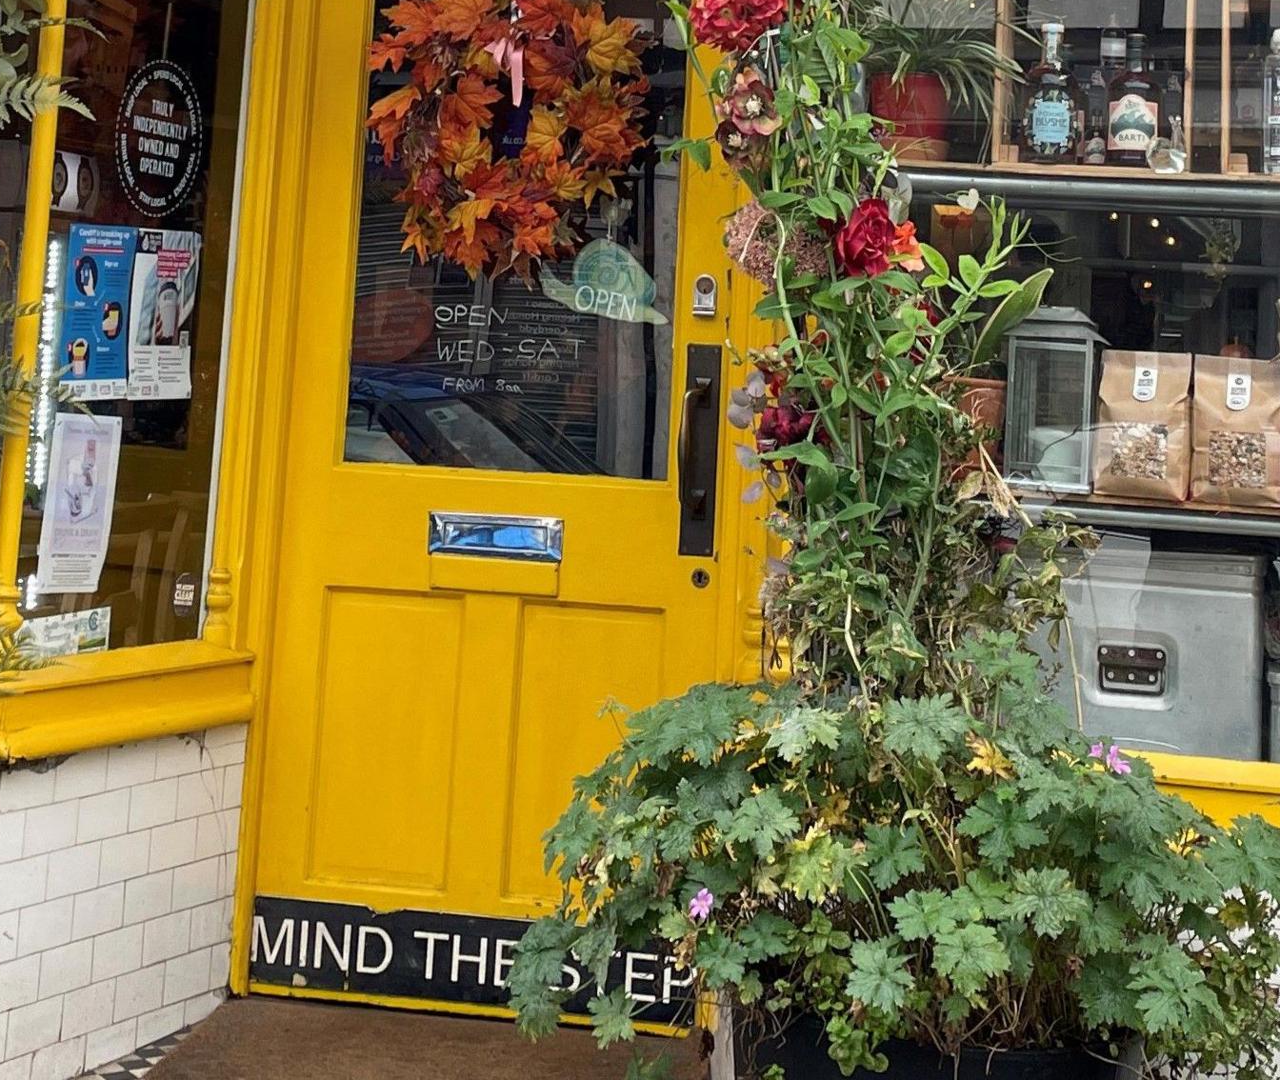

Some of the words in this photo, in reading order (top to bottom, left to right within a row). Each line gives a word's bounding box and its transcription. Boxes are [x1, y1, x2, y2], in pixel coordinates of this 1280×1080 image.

[152, 98, 175, 117] TRULY
[132, 115, 188, 141] INDEPENDENTLY
[1118, 133, 1146, 142] BARTI
[138, 137, 164, 155] OWNED
[164, 142, 180, 159] AND
[139, 157, 175, 178] OPERATED
[575, 285, 637, 321] OPEN
[434, 304, 509, 327] OPEN
[442, 377, 485, 393] FROM
[249, 914, 395, 975] MIND
[413, 930, 520, 988] THE
